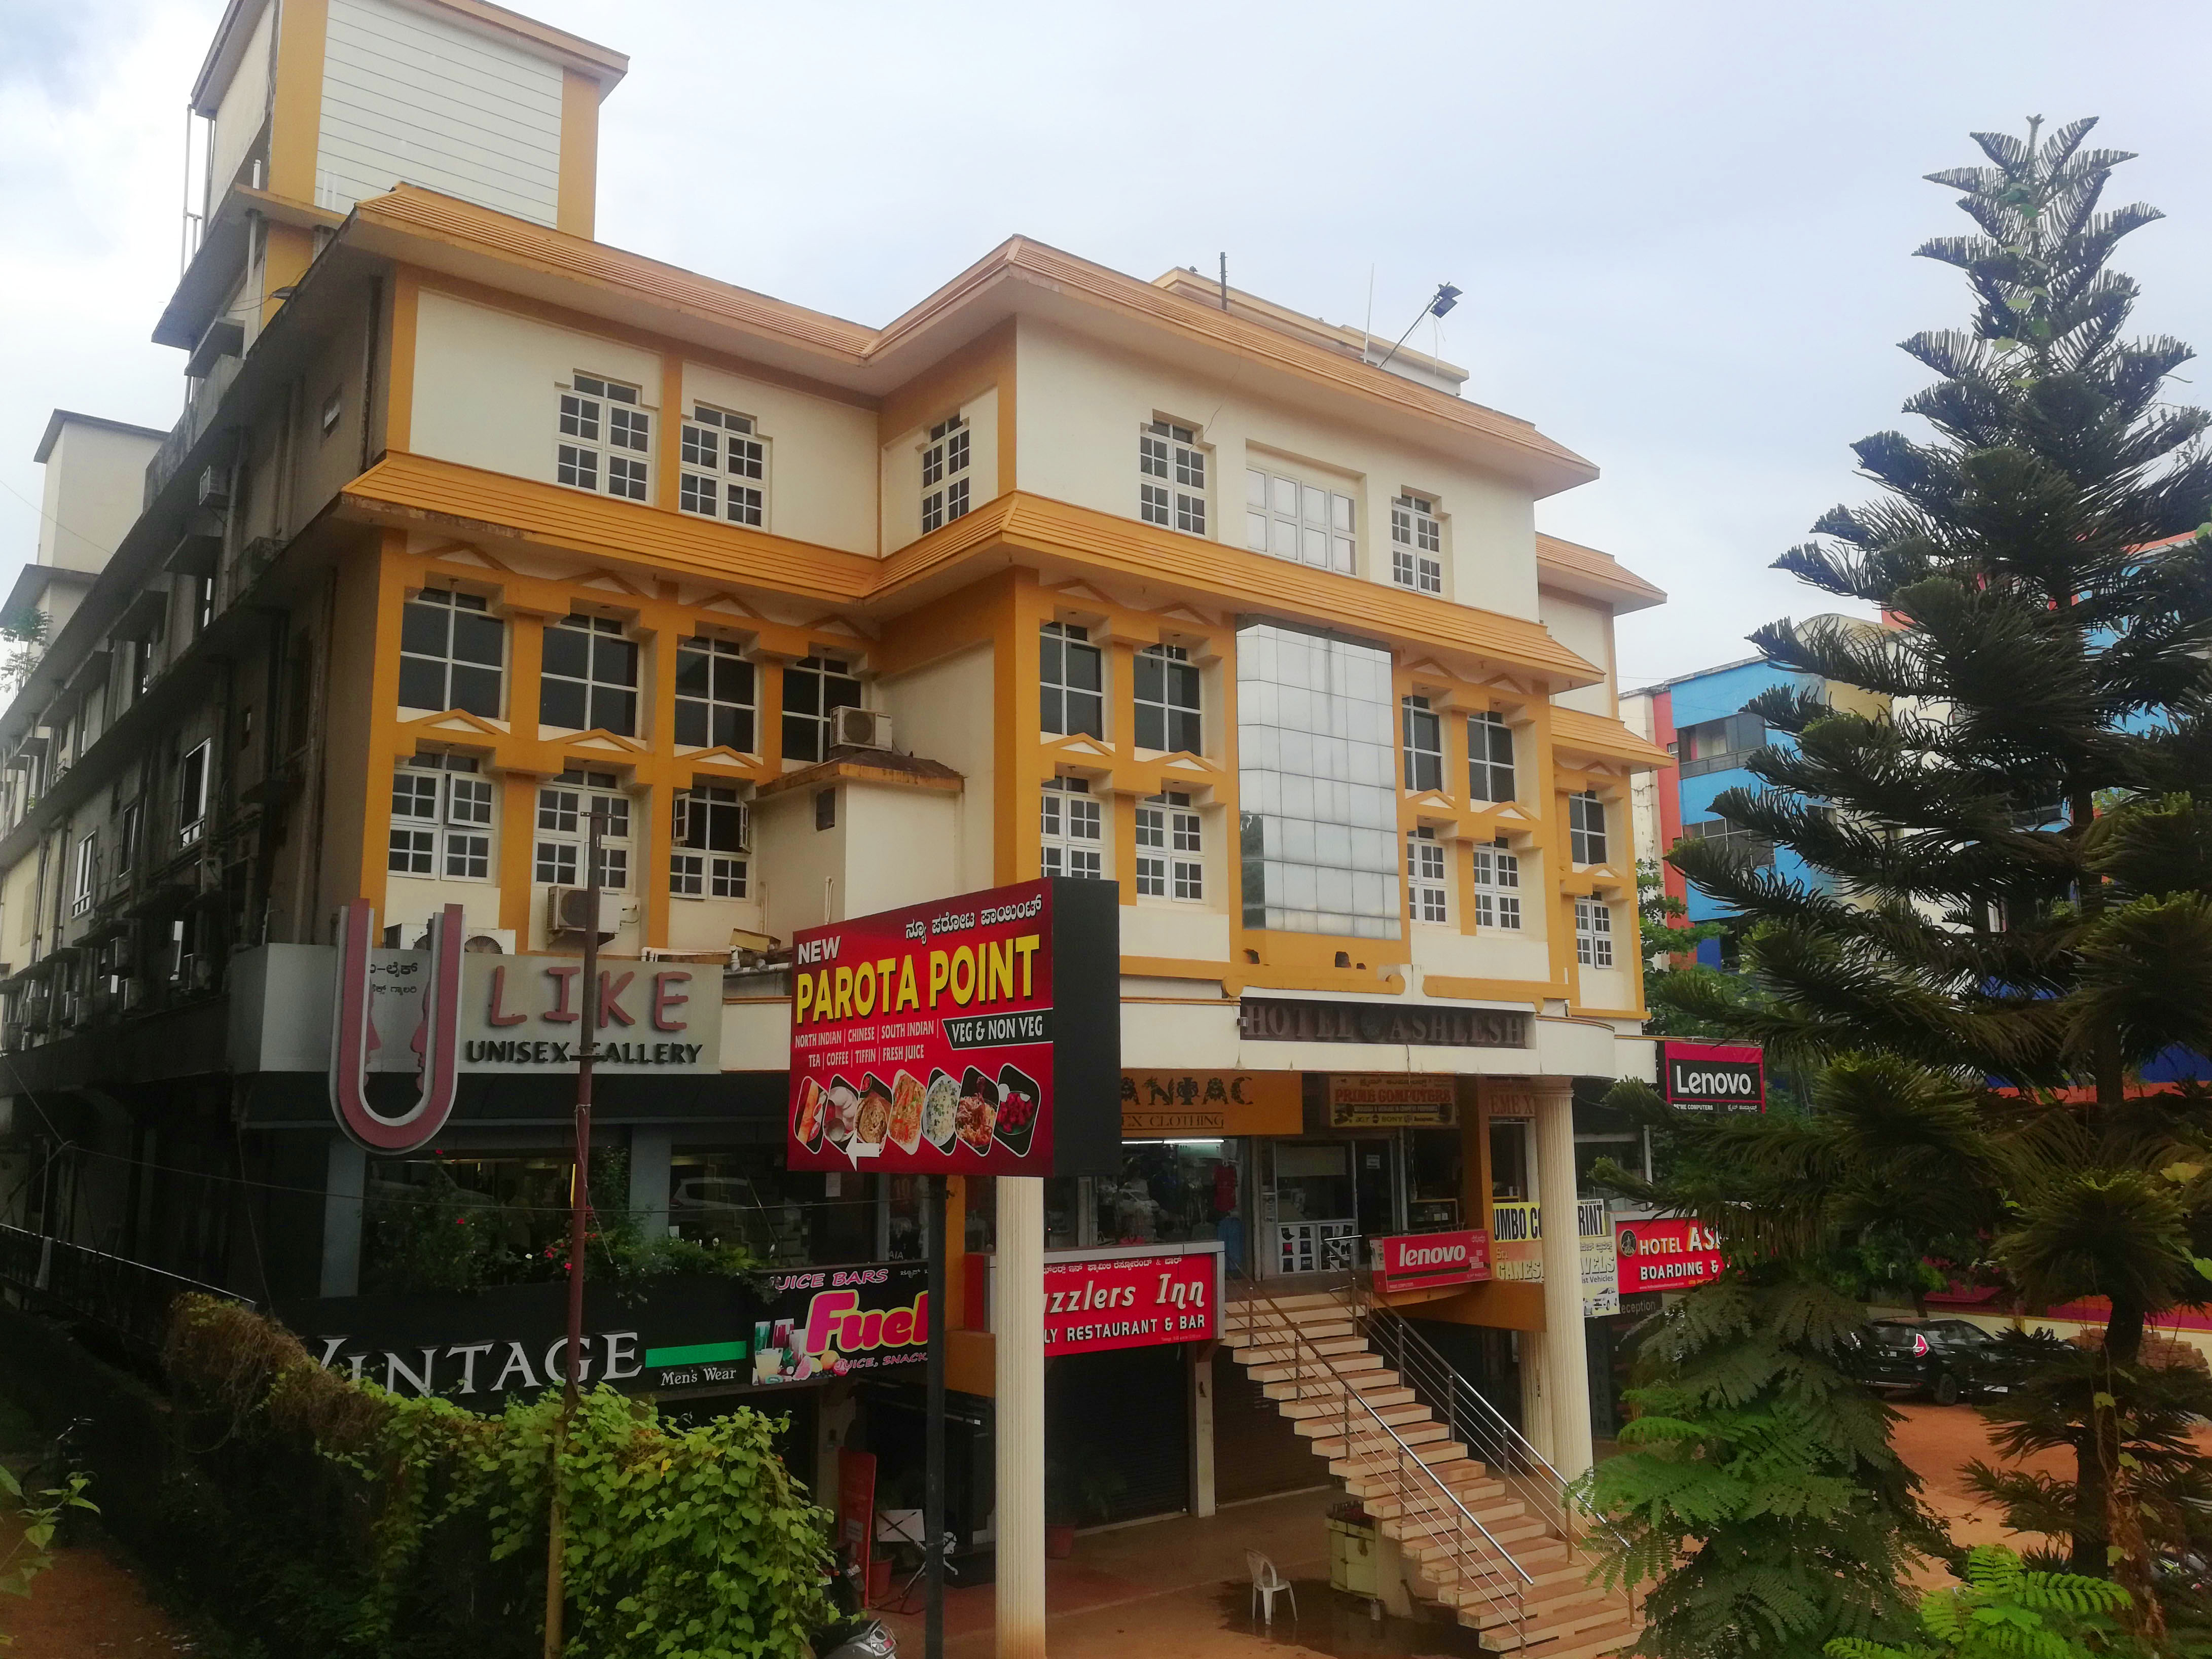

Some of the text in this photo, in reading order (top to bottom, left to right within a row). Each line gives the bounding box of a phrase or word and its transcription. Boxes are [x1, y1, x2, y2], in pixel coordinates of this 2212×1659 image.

[906, 919, 927, 944] ನ್ಯೂ
[798, 936, 841, 964] NEW
[796, 934, 1040, 1024] PAROTA POINT
[330, 898, 693, 1155] U LIKE
[795, 1020, 934, 1048] NORTH INDIAN CHINESE SOUTH INDIAN
[951, 1015, 1043, 1043] VEG & NON VEG
[1244, 1005, 1526, 1045] HOTEL ASHLESH
[466, 1039, 571, 1063] UNISEX
[808, 1044, 924, 1067] TEA COFFEE TIFFIN FRESH JUICE
[1676, 1065, 1752, 1095] Lenovo
[1335, 1089, 1451, 1102] PRIME COMPUTERS
[1149, 1115, 1224, 1129] CLOTHING
[1399, 1243, 1466, 1267] lenovo
[1639, 1237, 1683, 1256] HOTEL
[832, 1269, 889, 1286] BARS
[1589, 1275, 1614, 1283] Vehicles
[1640, 1260, 1719, 1280] BOARDING &
[1156, 1273, 1205, 1310] Inn
[1620, 1299, 1655, 1315] eception
[804, 1289, 928, 1356] Fuel
[1067, 1319, 1158, 1342] RESTAURANT
[1165, 1317, 1173, 1331] &
[1179, 1314, 1205, 1329] BAR
[882, 1352, 928, 1365] SNACK
[661, 1366, 737, 1386] Men's Wear
